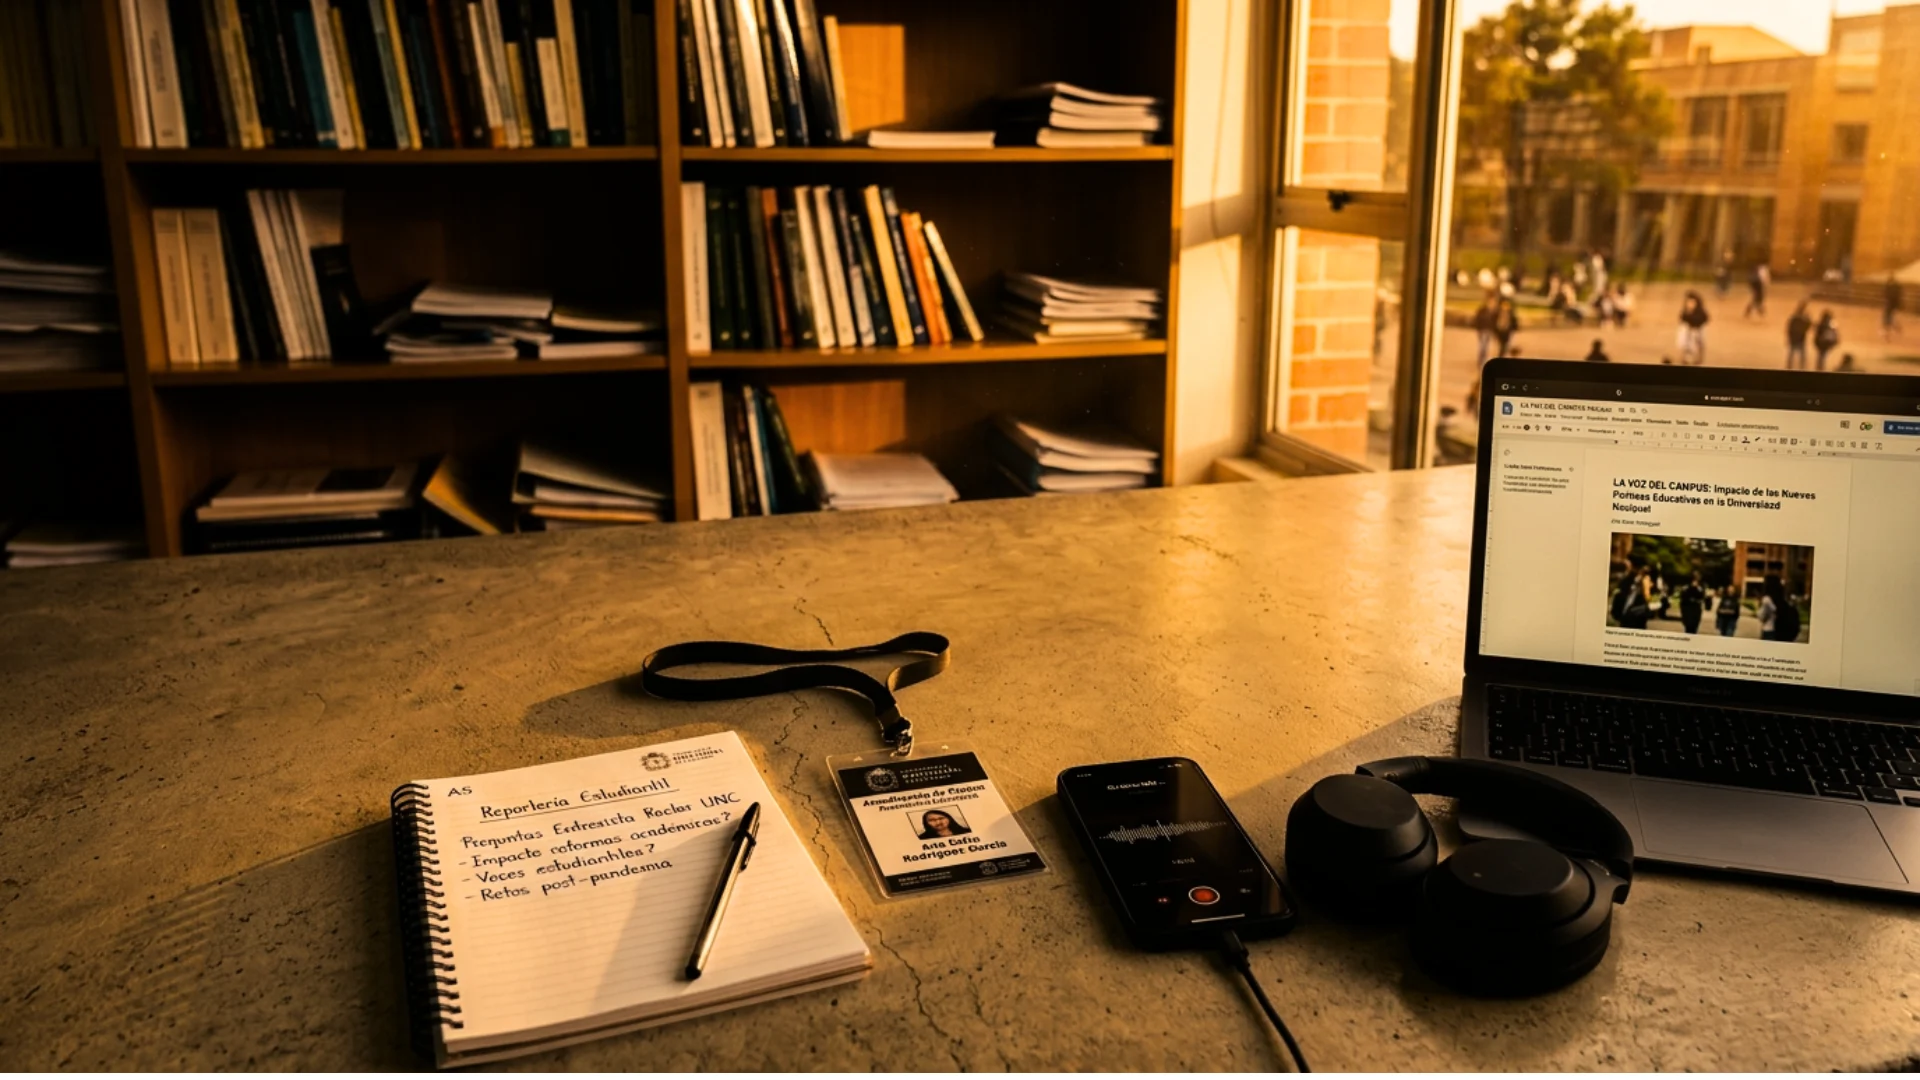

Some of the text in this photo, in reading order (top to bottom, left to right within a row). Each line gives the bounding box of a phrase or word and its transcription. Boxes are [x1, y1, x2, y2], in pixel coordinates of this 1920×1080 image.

[1613, 478, 1626, 487] LA
[1628, 479, 1647, 488] VOZ
[1648, 480, 1667, 490] DEL
[1752, 487, 1764, 496] de
[447, 786, 473, 797] AS
[700, 792, 741, 808] UNC
[476, 870, 525, 883] Voces
[480, 886, 530, 901] Retos
